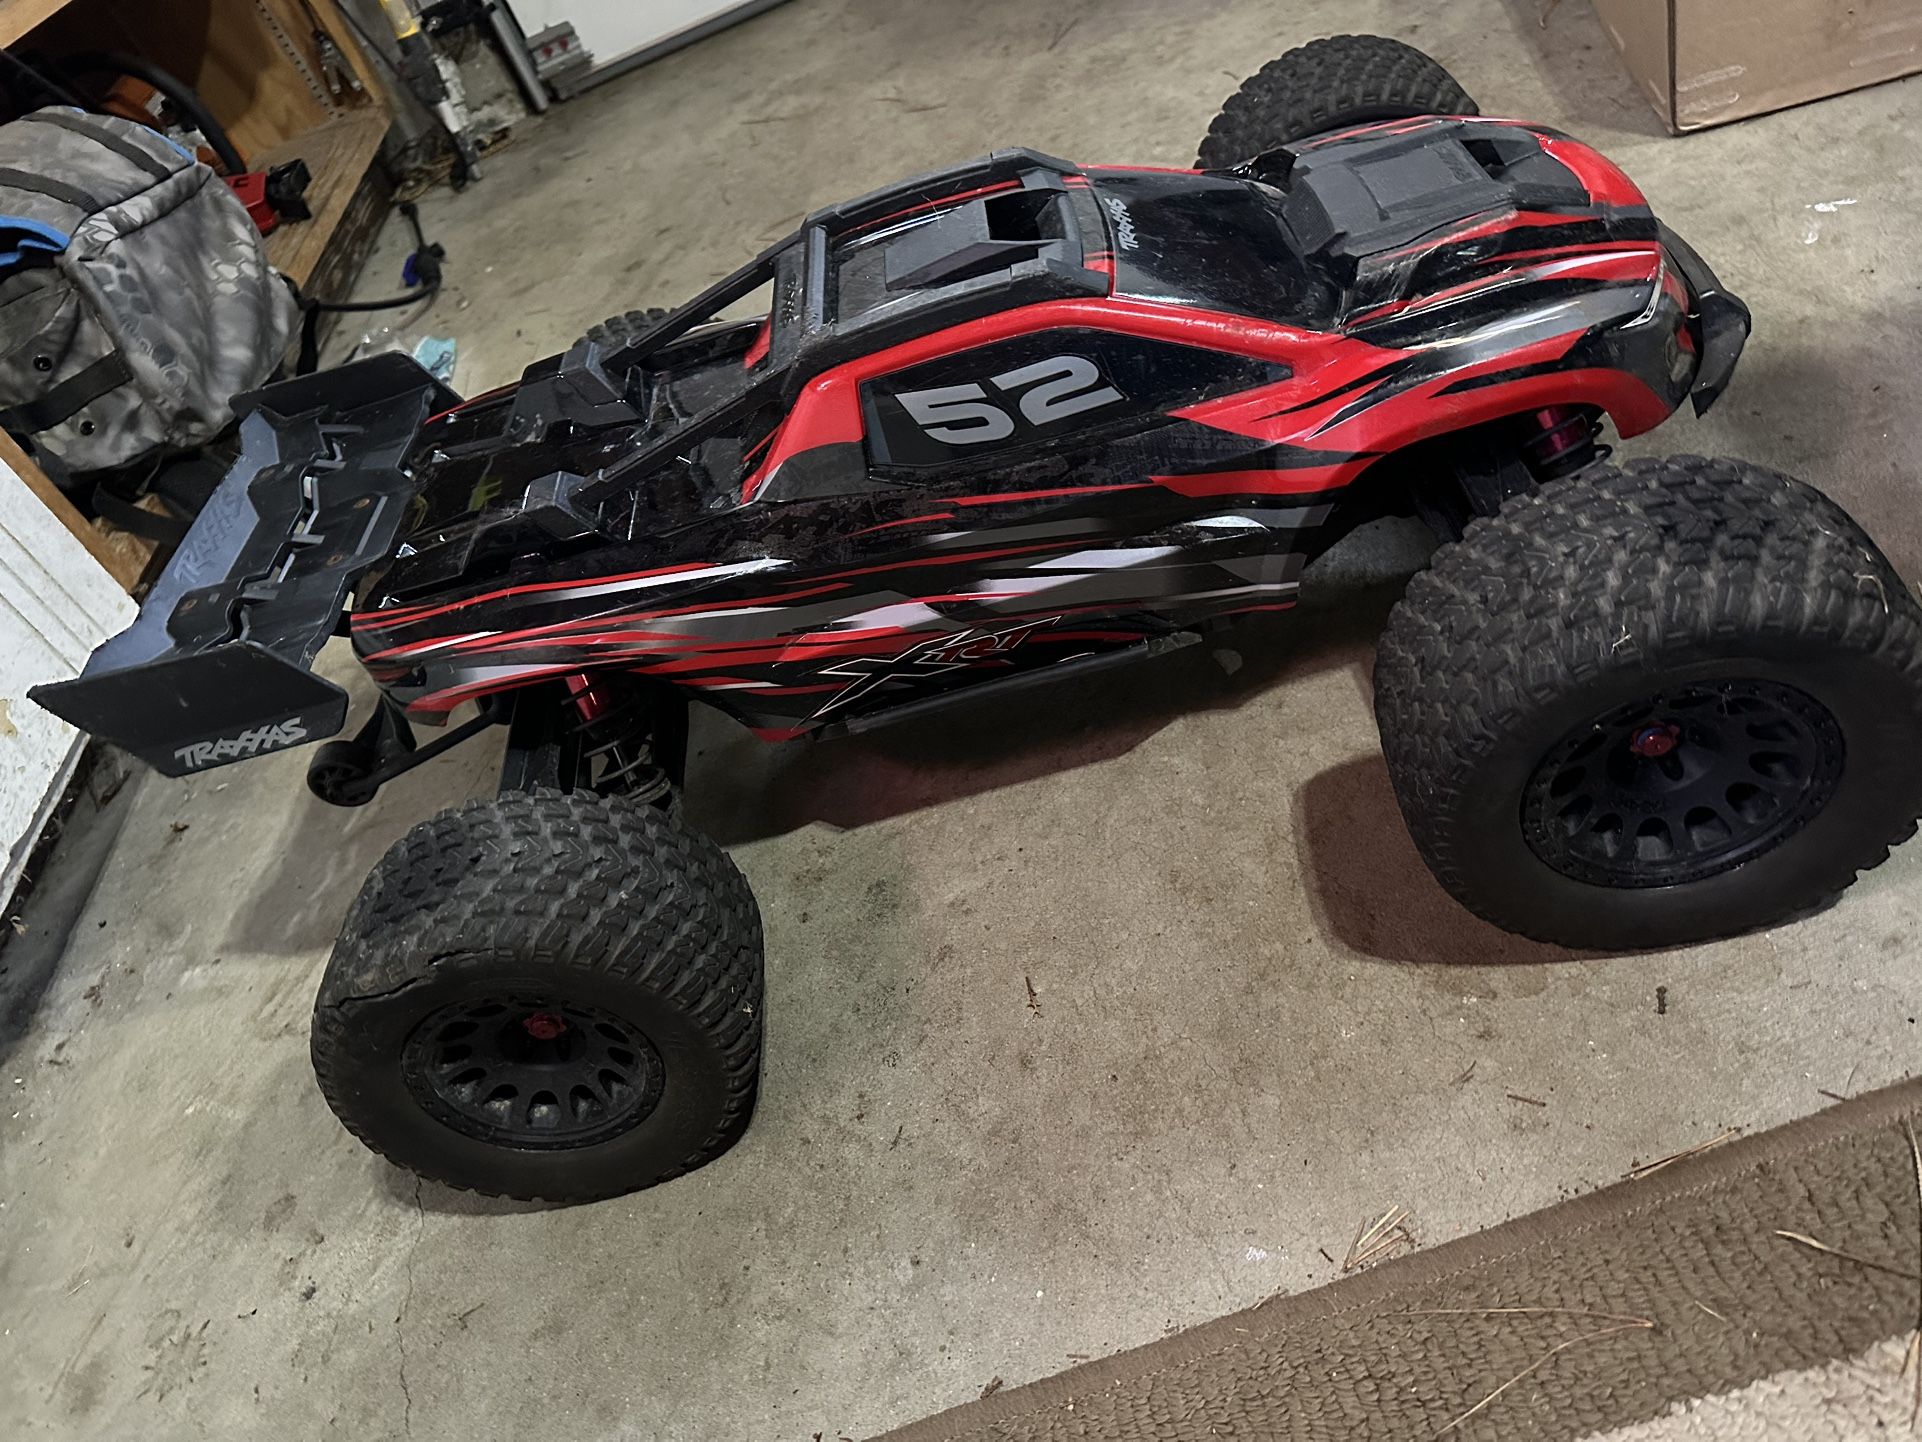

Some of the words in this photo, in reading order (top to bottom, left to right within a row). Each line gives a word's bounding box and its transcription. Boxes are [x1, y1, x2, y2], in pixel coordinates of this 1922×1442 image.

[1103, 197, 1139, 251] TRAXXAS
[894, 355, 1124, 445] 52
[174, 716, 307, 768] TRAXXAS
